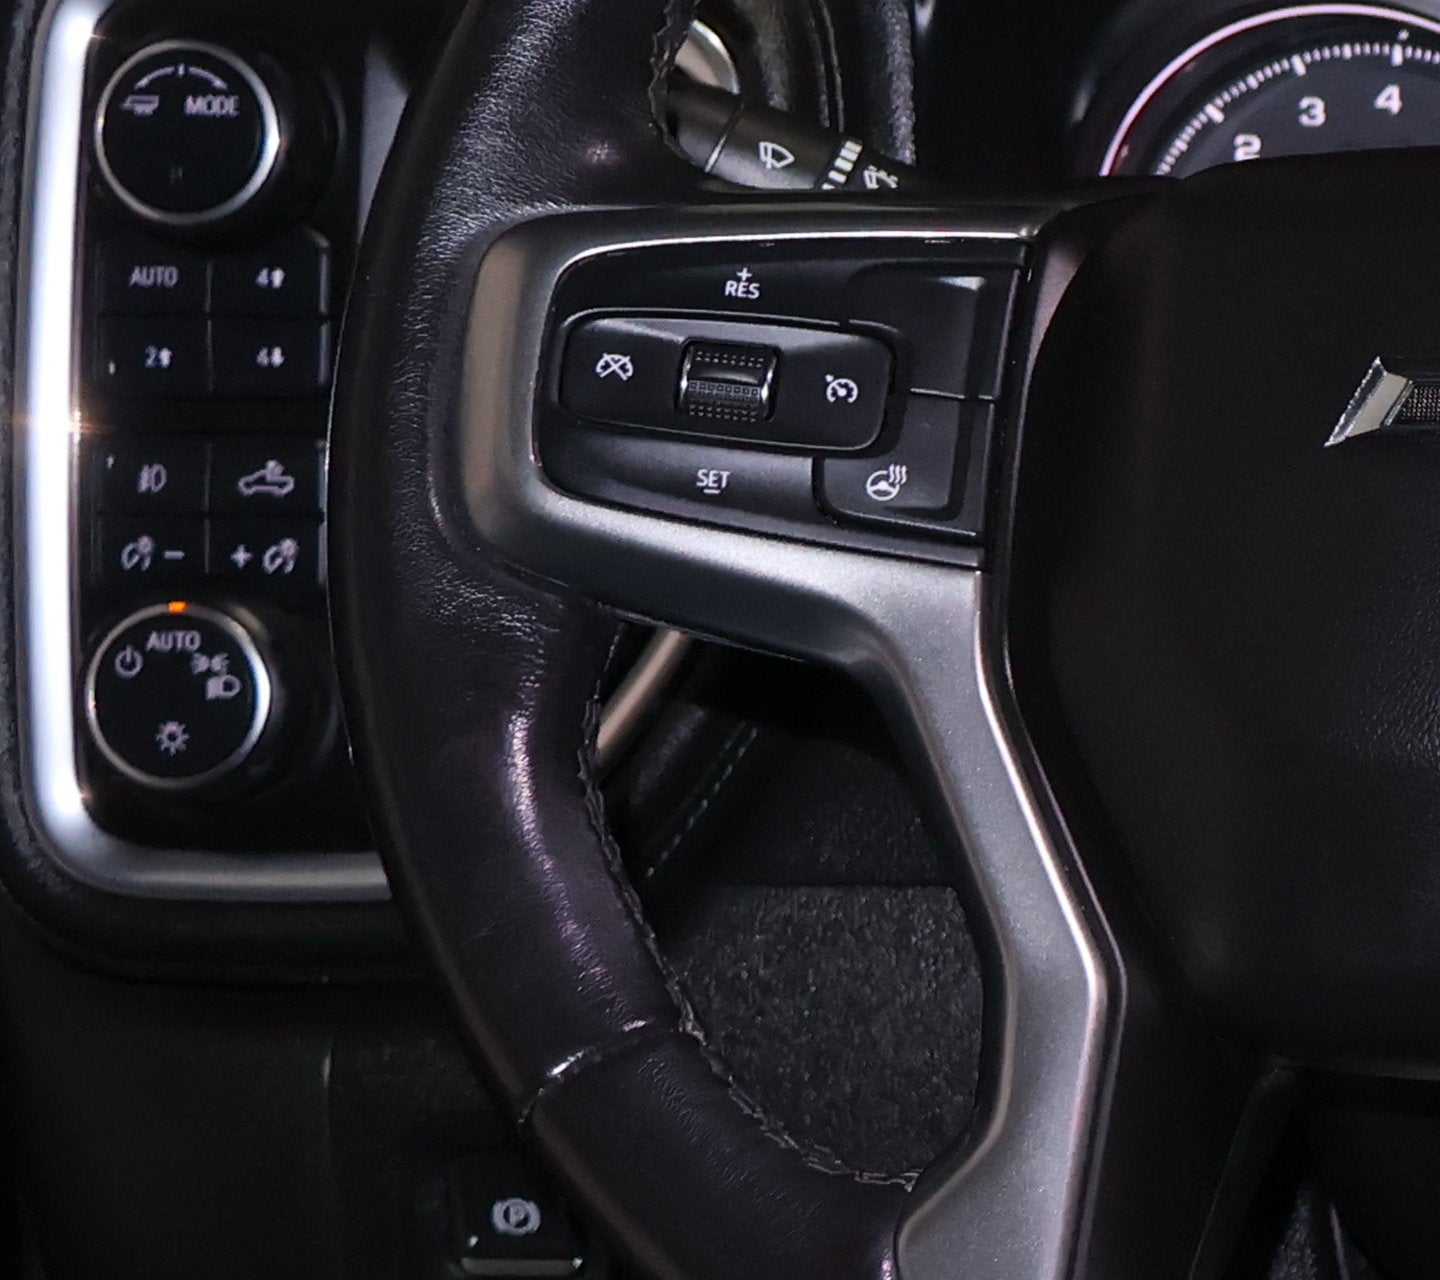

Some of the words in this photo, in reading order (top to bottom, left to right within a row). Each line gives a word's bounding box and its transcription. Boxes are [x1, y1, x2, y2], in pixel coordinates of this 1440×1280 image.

[184, 95, 241, 117] MODE
[1298, 95, 1327, 128] 3
[1374, 84, 1403, 116] 4
[1232, 133, 1262, 161] 2
[129, 265, 181, 288] AUTO
[723, 281, 762, 300] RES
[695, 468, 732, 489] SET
[146, 629, 203, 652] AUTO
